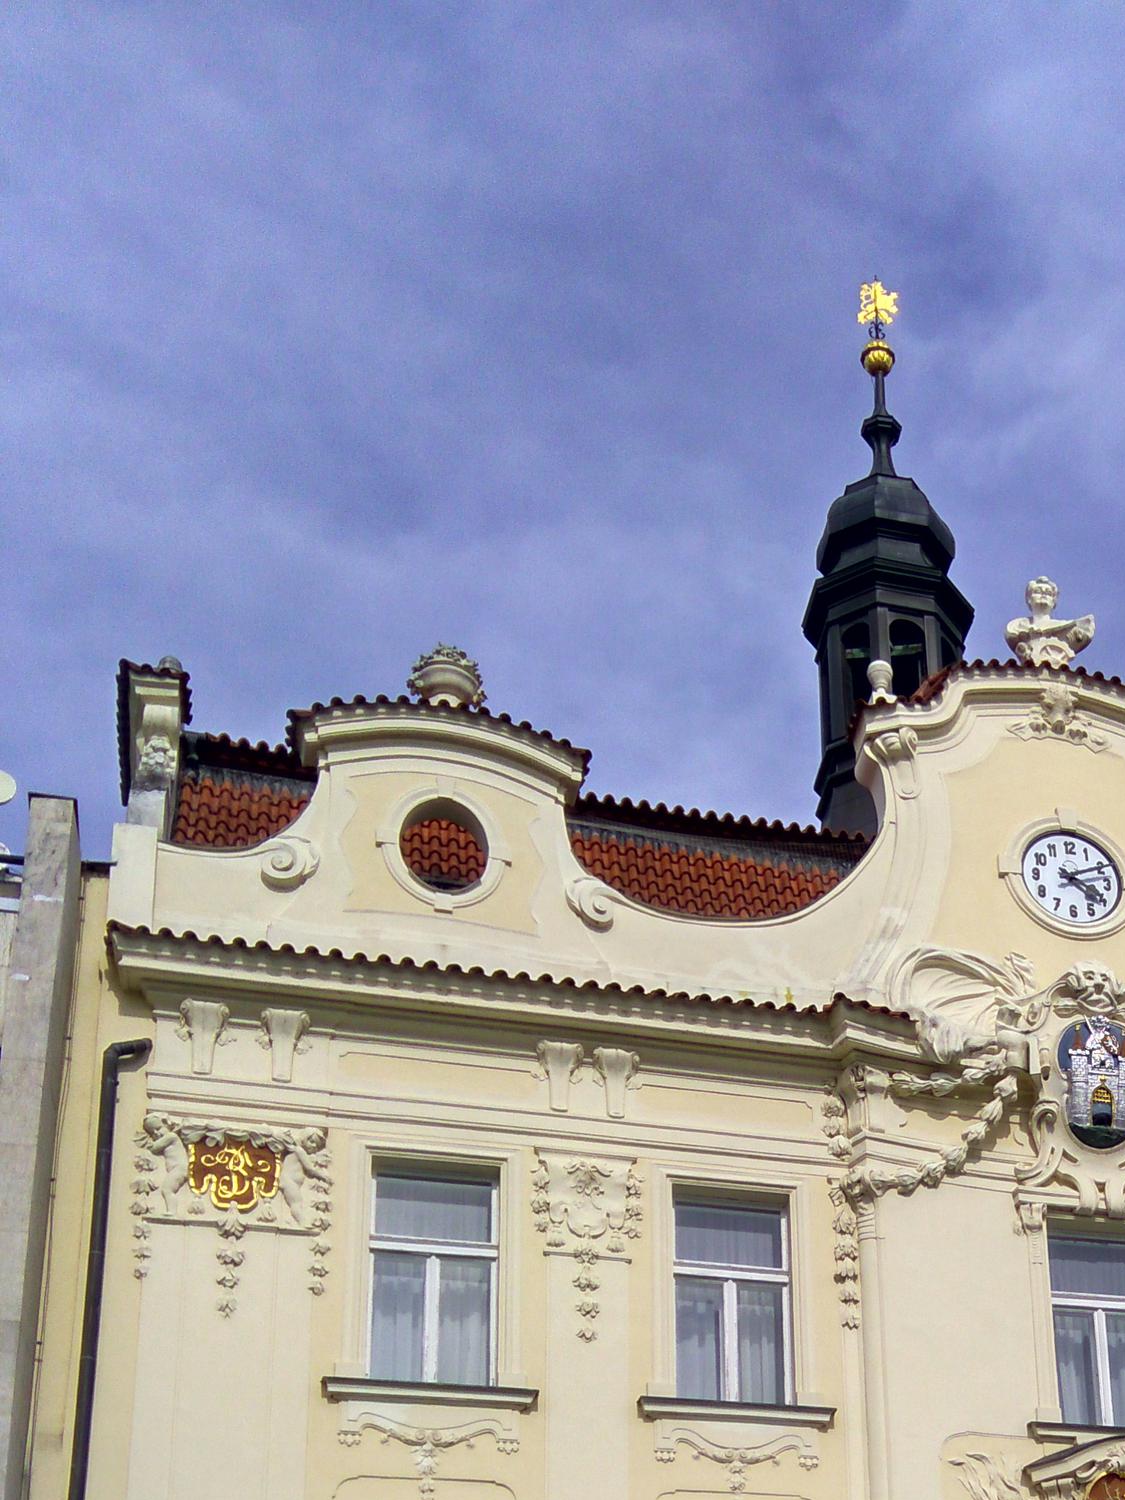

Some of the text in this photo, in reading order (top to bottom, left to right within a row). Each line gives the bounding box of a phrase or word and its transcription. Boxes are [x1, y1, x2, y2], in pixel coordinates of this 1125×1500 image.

[1047, 843, 1057, 858] 11
[1063, 841, 1076, 855] 12
[1082, 847, 1089, 861] 1
[1034, 852, 1047, 867] 10
[1031, 867, 1041, 881] 9
[1096, 861, 1105, 875] 2
[1038, 884, 1046, 898] 8
[1103, 877, 1111, 892] 3
[1053, 897, 1061, 911] 7
[1069, 904, 1078, 918] 6
[1087, 902, 1096, 917] 5
